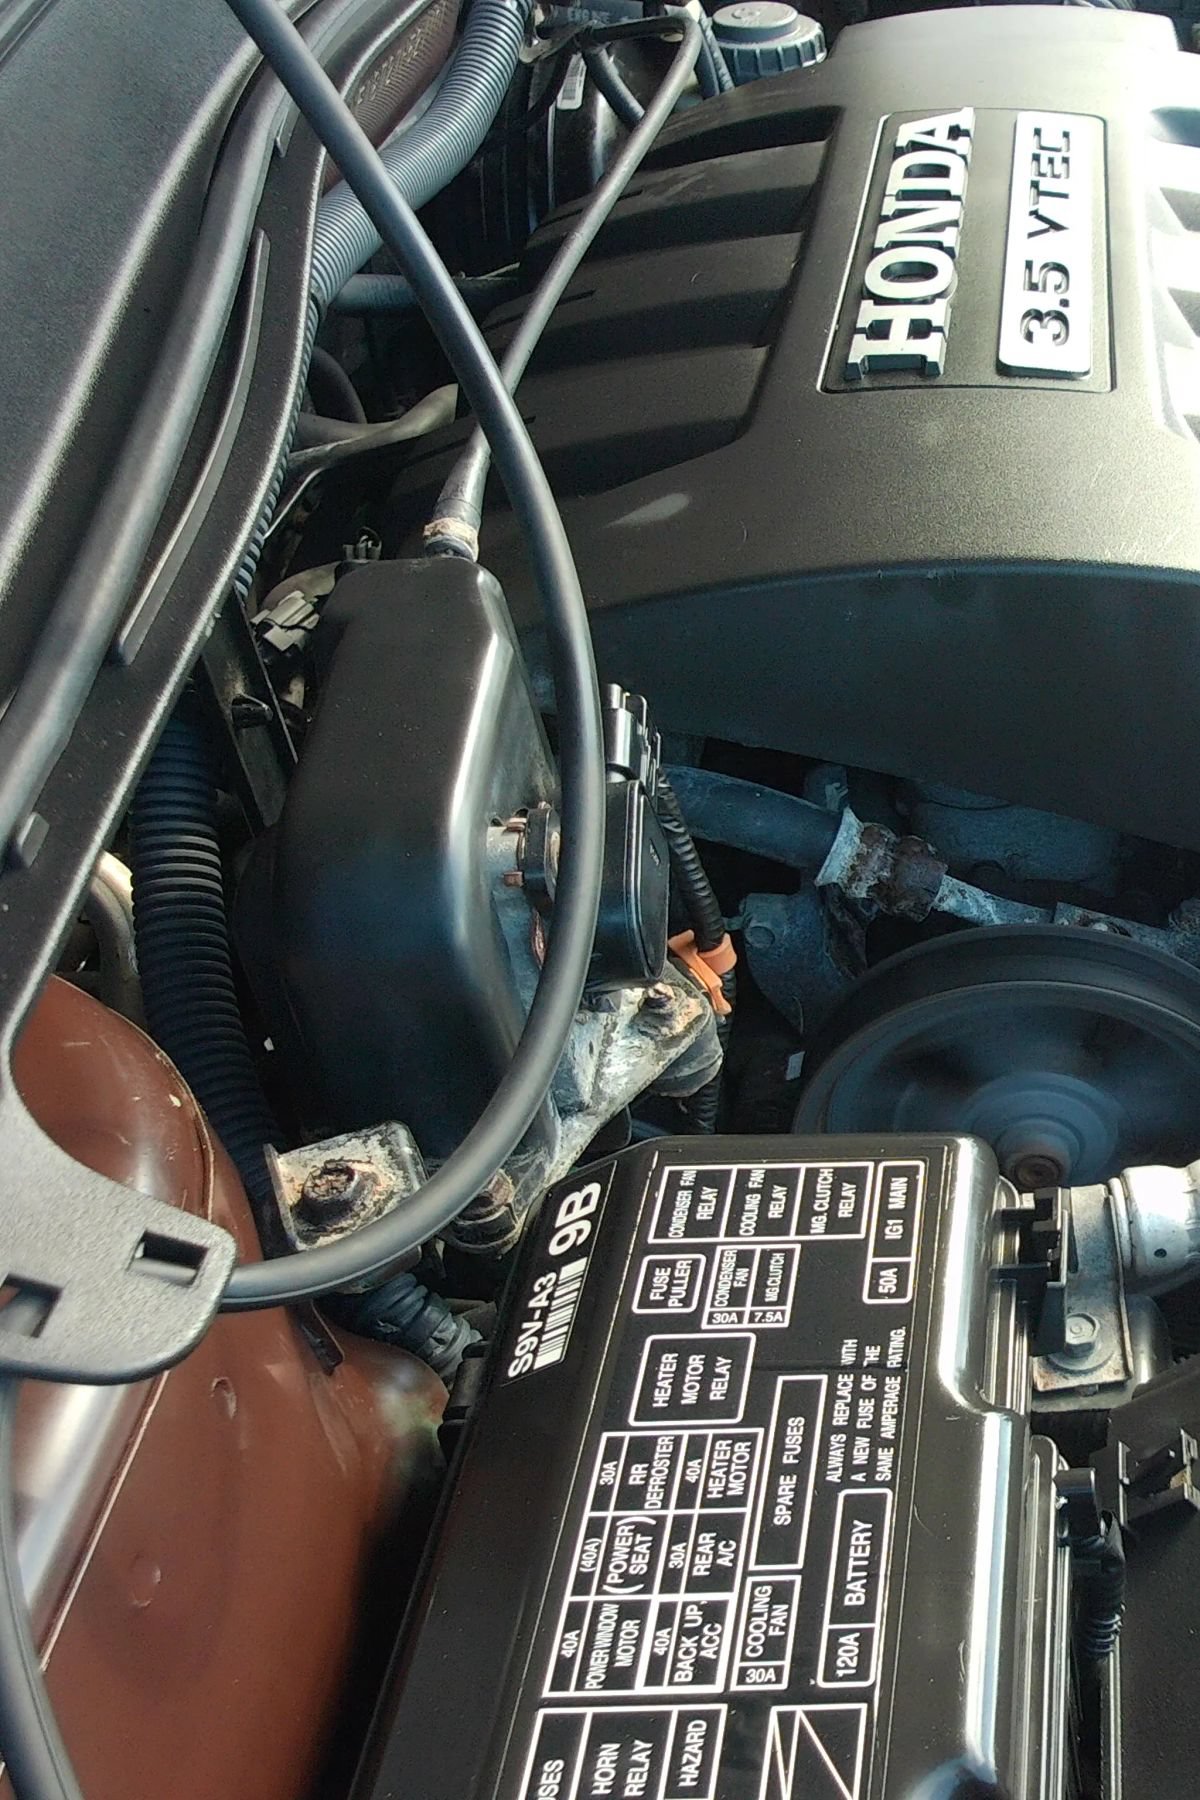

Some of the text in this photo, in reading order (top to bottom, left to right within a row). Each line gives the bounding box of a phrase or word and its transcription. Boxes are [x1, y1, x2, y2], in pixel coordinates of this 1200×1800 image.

[844, 107, 975, 379] HONDA
[1021, 127, 1070, 346] 3.5 VTEC
[549, 1182, 601, 1256] 9B
[669, 1170, 698, 1238] CONDENSER FAN
[696, 1186, 719, 1220] RELAY
[739, 1169, 767, 1236] COOLING FAN
[768, 1185, 789, 1218] RELAY
[811, 1169, 834, 1234] MG. CLUTCH
[838, 1184, 857, 1218] RELAY
[884, 1177, 907, 1240] IG1 MAIN
[650, 1266, 671, 1300] FUSE
[668, 1261, 691, 1307] PULLER
[715, 1250, 737, 1307] CONDENSER
[734, 1268, 749, 1290] FAN
[879, 1268, 896, 1295] 50A
[509, 1274, 557, 1378] S9V-A3
[712, 1313, 738, 1324] 30A
[753, 1311, 783, 1322] 7.5A
[653, 1354, 677, 1407] HEATER
[681, 1354, 705, 1404] MOTOR
[710, 1356, 733, 1400] RELAY
[833, 1373, 854, 1425] REPLACE
[852, 1345, 880, 1481] A NEW FUSE OF THE
[876, 1326, 906, 1480] SAME AMPERAGE RATING.
[600, 1461, 618, 1485] 30A
[629, 1462, 648, 1485] RR
[646, 1436, 675, 1509] DEFROSTER
[686, 1459, 701, 1483] 40A
[707, 1439, 732, 1498] HEATER
[729, 1441, 751, 1496] MOTOR
[774, 1416, 805, 1525] SPARE FUSES
[826, 1433, 847, 1482] ALWAYS
[581, 1537, 602, 1572] (40A)
[669, 1541, 686, 1568] 30A
[693, 1532, 716, 1576] REAR
[717, 1541, 737, 1567] A/C
[844, 1520, 872, 1606] BATTERY
[561, 1630, 581, 1657] 40A
[614, 1619, 640, 1667] MOTOR
[654, 1627, 671, 1655] 40A
[701, 1622, 722, 1659] ACC
[745, 1586, 772, 1657] COOLING
[769, 1604, 789, 1635] FAN
[674, 1634, 695, 1682] BACK
[746, 1669, 775, 1683] 30A
[837, 1632, 860, 1678] 120A
[592, 1744, 620, 1794] HORN
[624, 1740, 653, 1797] RELAY
[679, 1720, 707, 1787] HAZARD
